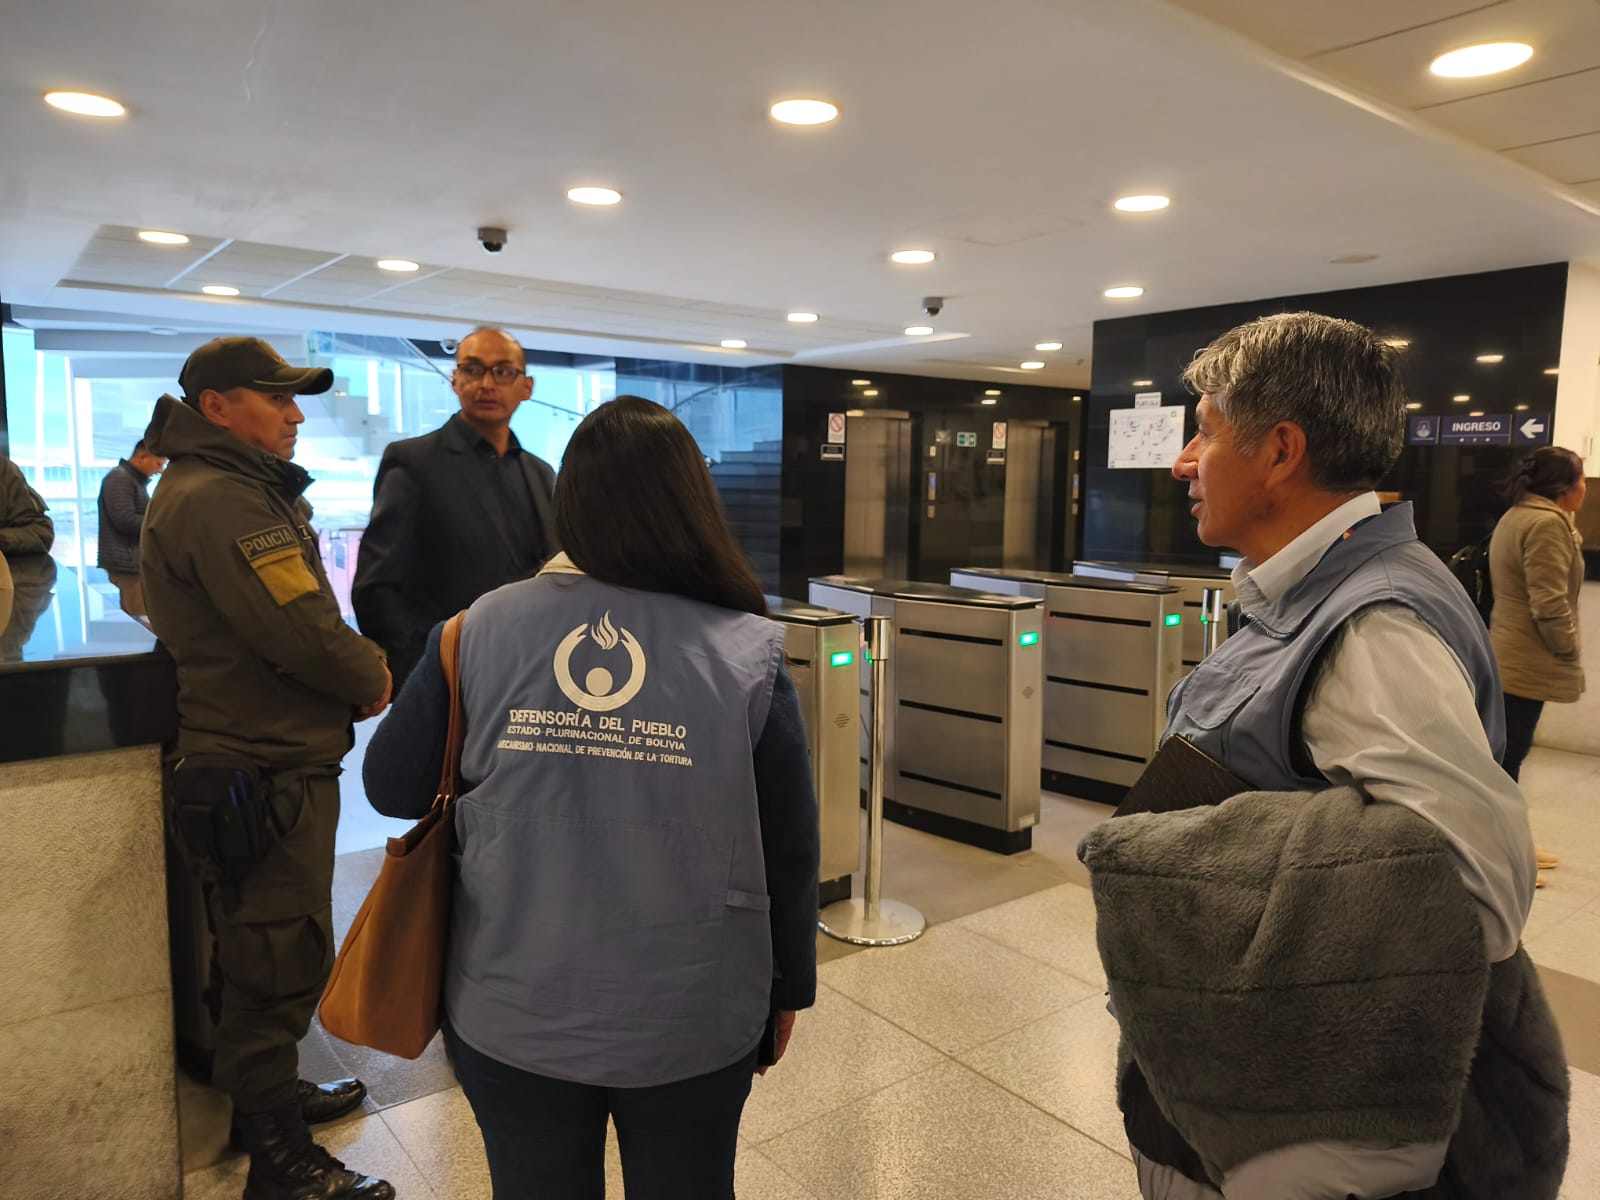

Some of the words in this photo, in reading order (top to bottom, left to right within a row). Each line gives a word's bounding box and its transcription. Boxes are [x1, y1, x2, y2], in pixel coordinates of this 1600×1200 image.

[1452, 421, 1501, 432] INGRESO
[242, 528, 293, 556] POLICIA
[509, 708, 592, 728] DEFENSORÍA
[599, 716, 625, 731] DEL
[631, 719, 687, 739] PUEBLO
[507, 725, 541, 736] ESTADO
[545, 728, 625, 744] PLURINACIONAL
[628, 735, 642, 745] DE
[645, 738, 686, 752] BOLIVIA
[536, 742, 573, 754] NACIONAL
[575, 745, 585, 754] DE
[587, 747, 632, 761] PREVENCIÓN
[634, 751, 645, 761] DE
[646, 752, 657, 763] LA
[660, 753, 693, 767] TORTURA
